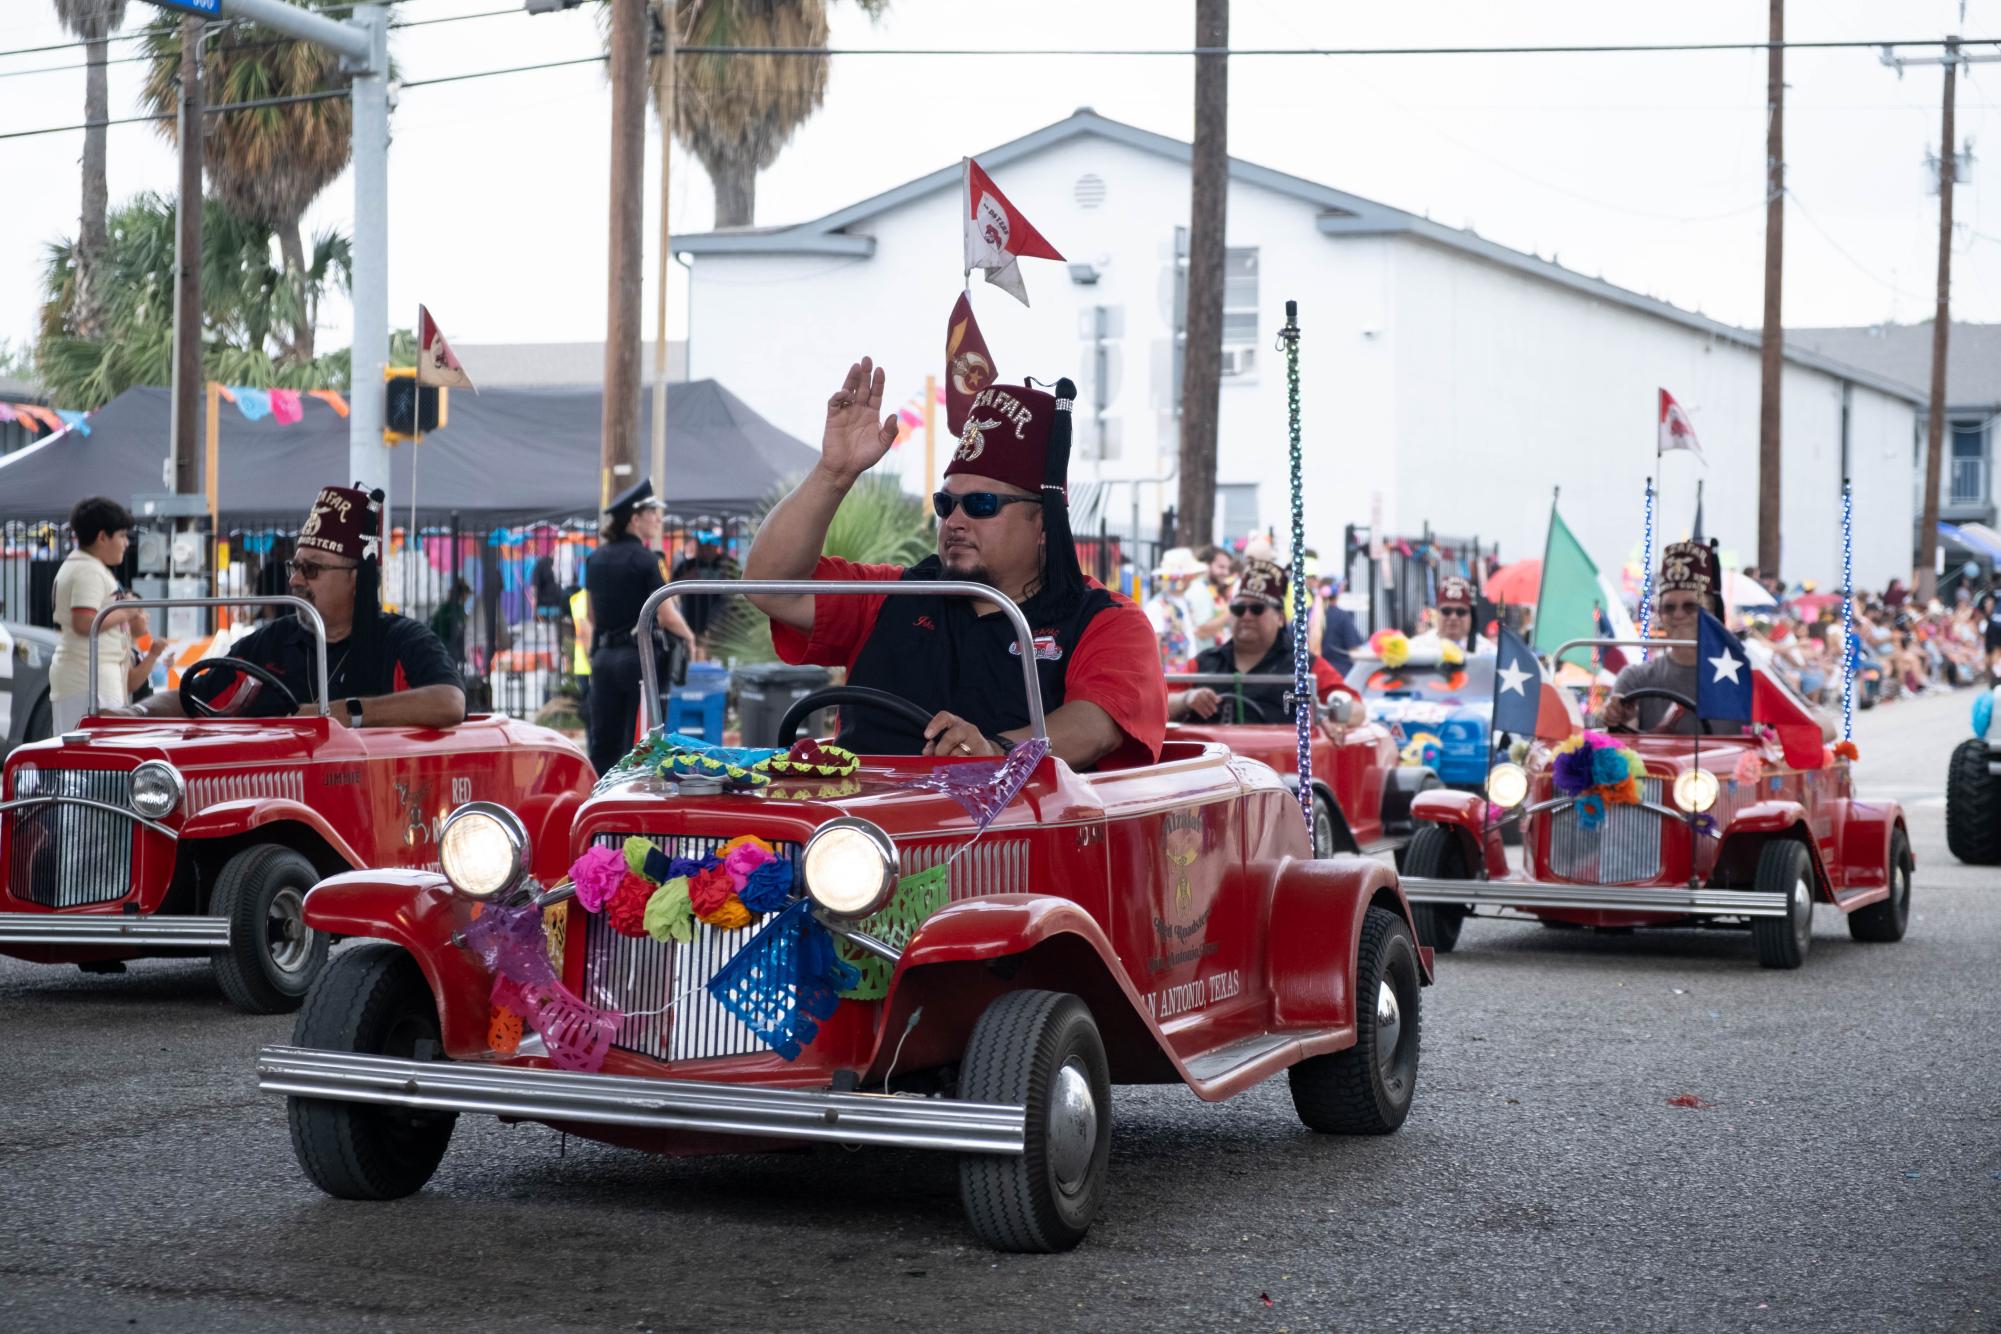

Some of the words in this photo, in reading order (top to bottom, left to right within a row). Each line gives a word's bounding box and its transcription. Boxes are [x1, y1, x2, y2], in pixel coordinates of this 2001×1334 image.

[452, 777, 472, 804] RED
[1160, 979, 1207, 1018] ANTONIO,
[1209, 968, 1240, 1003] TEXAS
